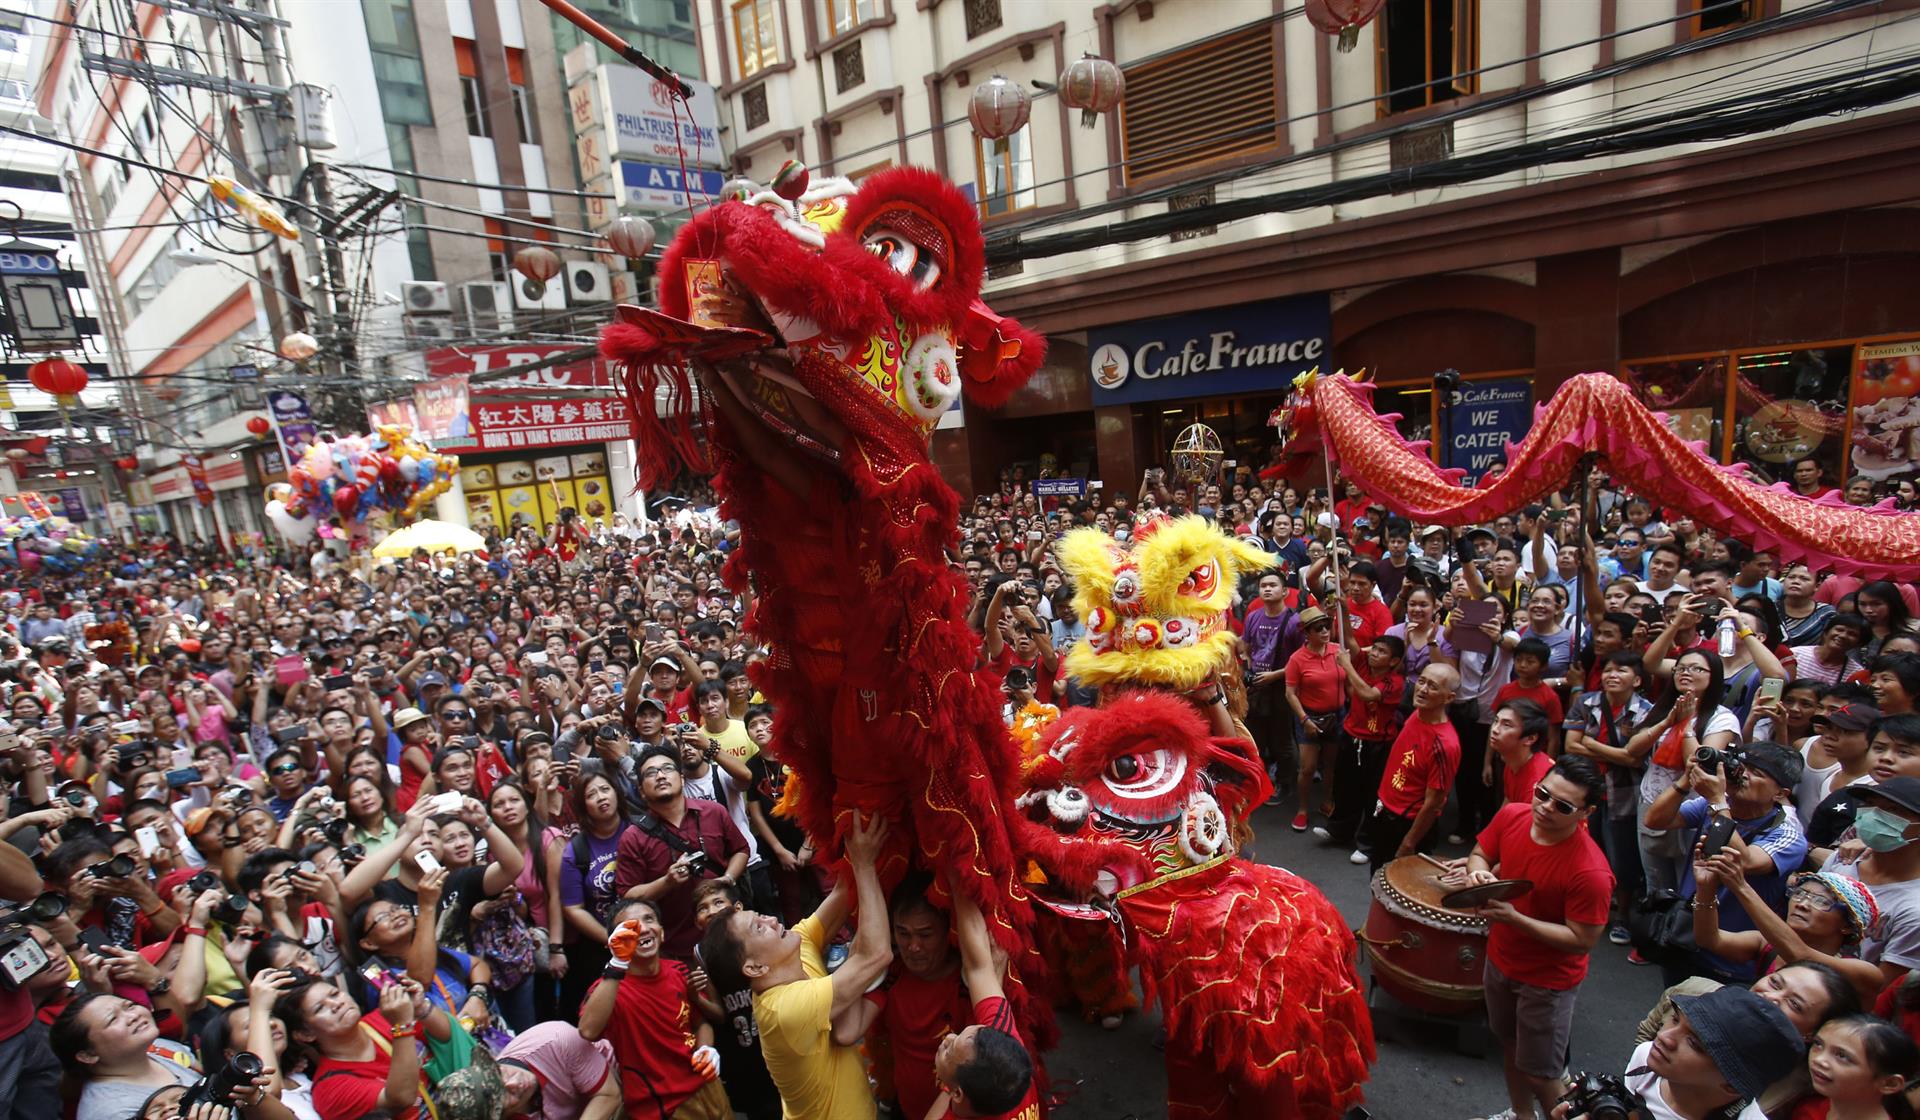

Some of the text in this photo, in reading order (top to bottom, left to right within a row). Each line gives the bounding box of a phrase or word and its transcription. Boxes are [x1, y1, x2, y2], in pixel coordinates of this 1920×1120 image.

[683, 124, 714, 141] BANK
[653, 144, 688, 157] ONGPN
[649, 168, 703, 190] ATM
[0, 253, 56, 271] BDO
[1134, 331, 1323, 380] CafeFrance
[1464, 387, 1526, 403] CafeFrance
[1471, 410, 1499, 427] WE
[510, 430, 525, 446] TAI
[525, 429, 549, 445] YANG
[550, 426, 585, 443] CHINESE
[585, 423, 631, 441] DRUGSTORE
[1454, 431, 1511, 449] CATER
